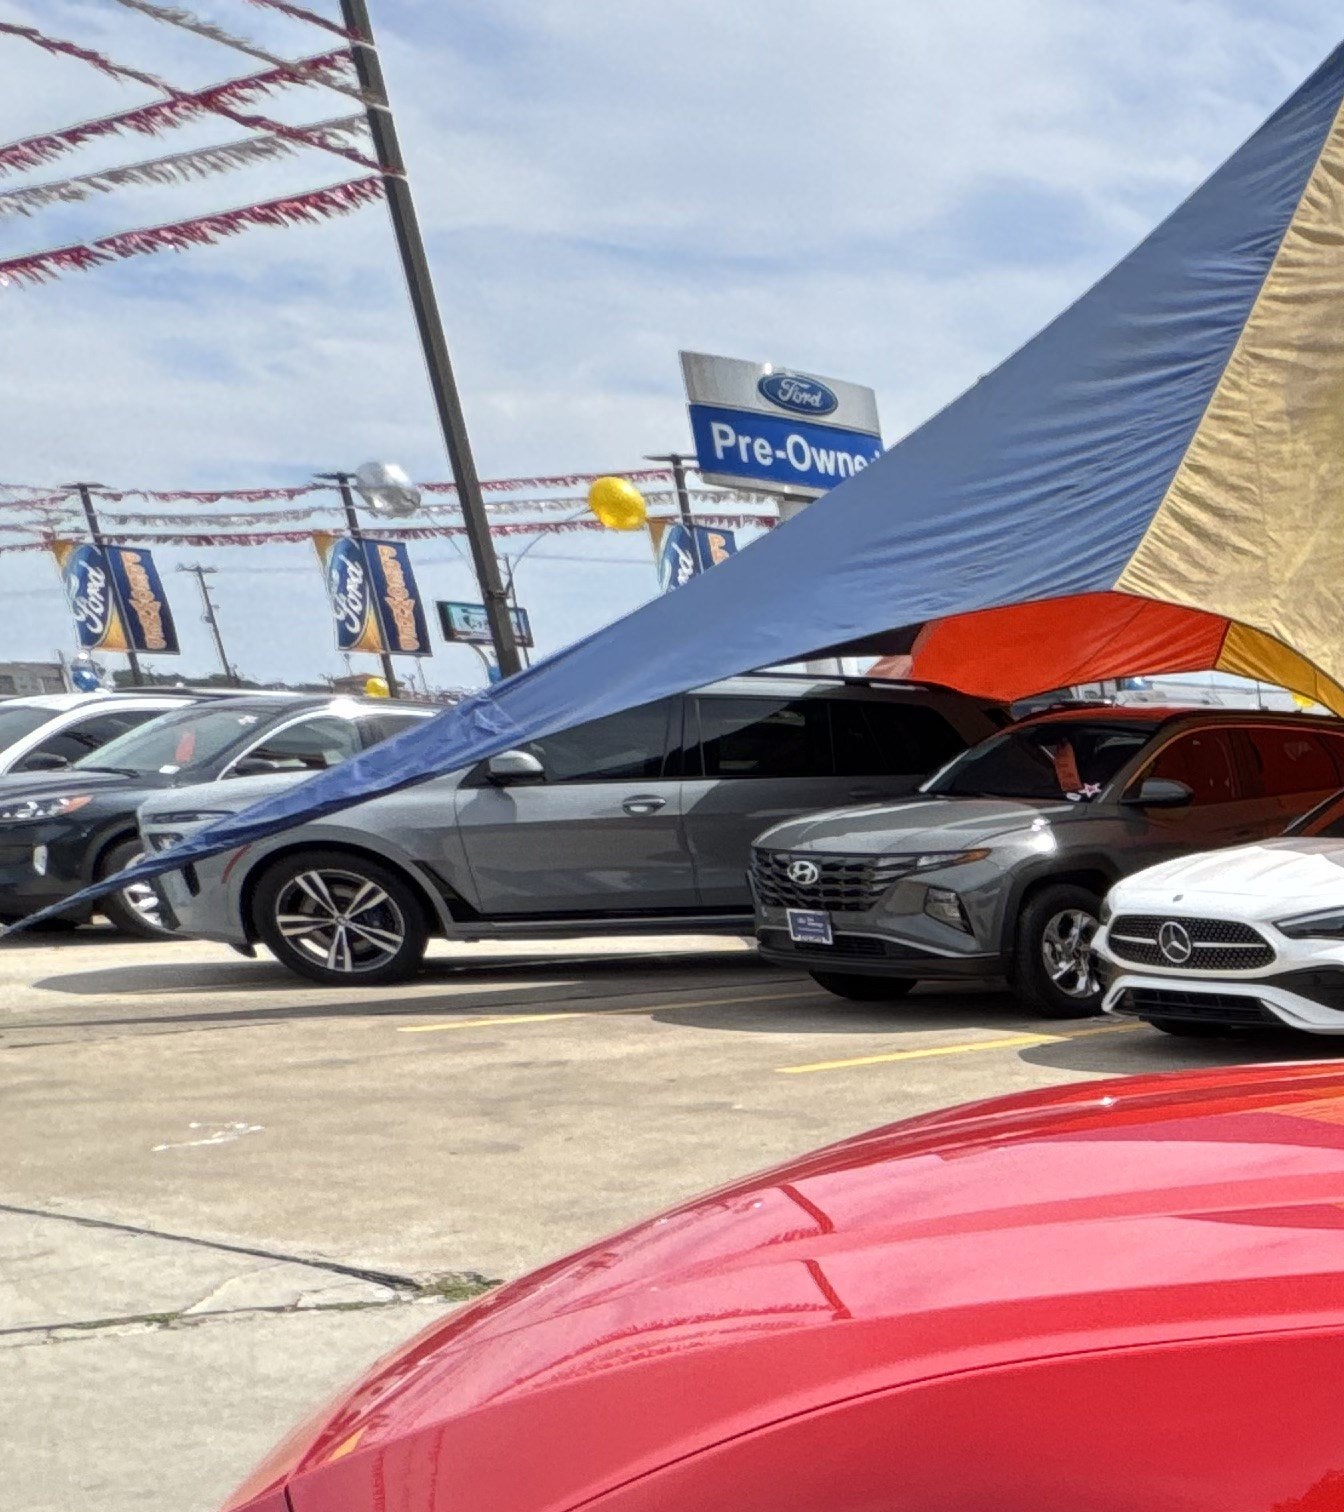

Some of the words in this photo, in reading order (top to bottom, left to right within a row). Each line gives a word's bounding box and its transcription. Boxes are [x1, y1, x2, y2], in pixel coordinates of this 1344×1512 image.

[778, 378, 822, 408] Ford
[711, 421, 880, 478] Pre-Owne
[70, 559, 106, 634] Ford
[332, 554, 364, 634] Ford
